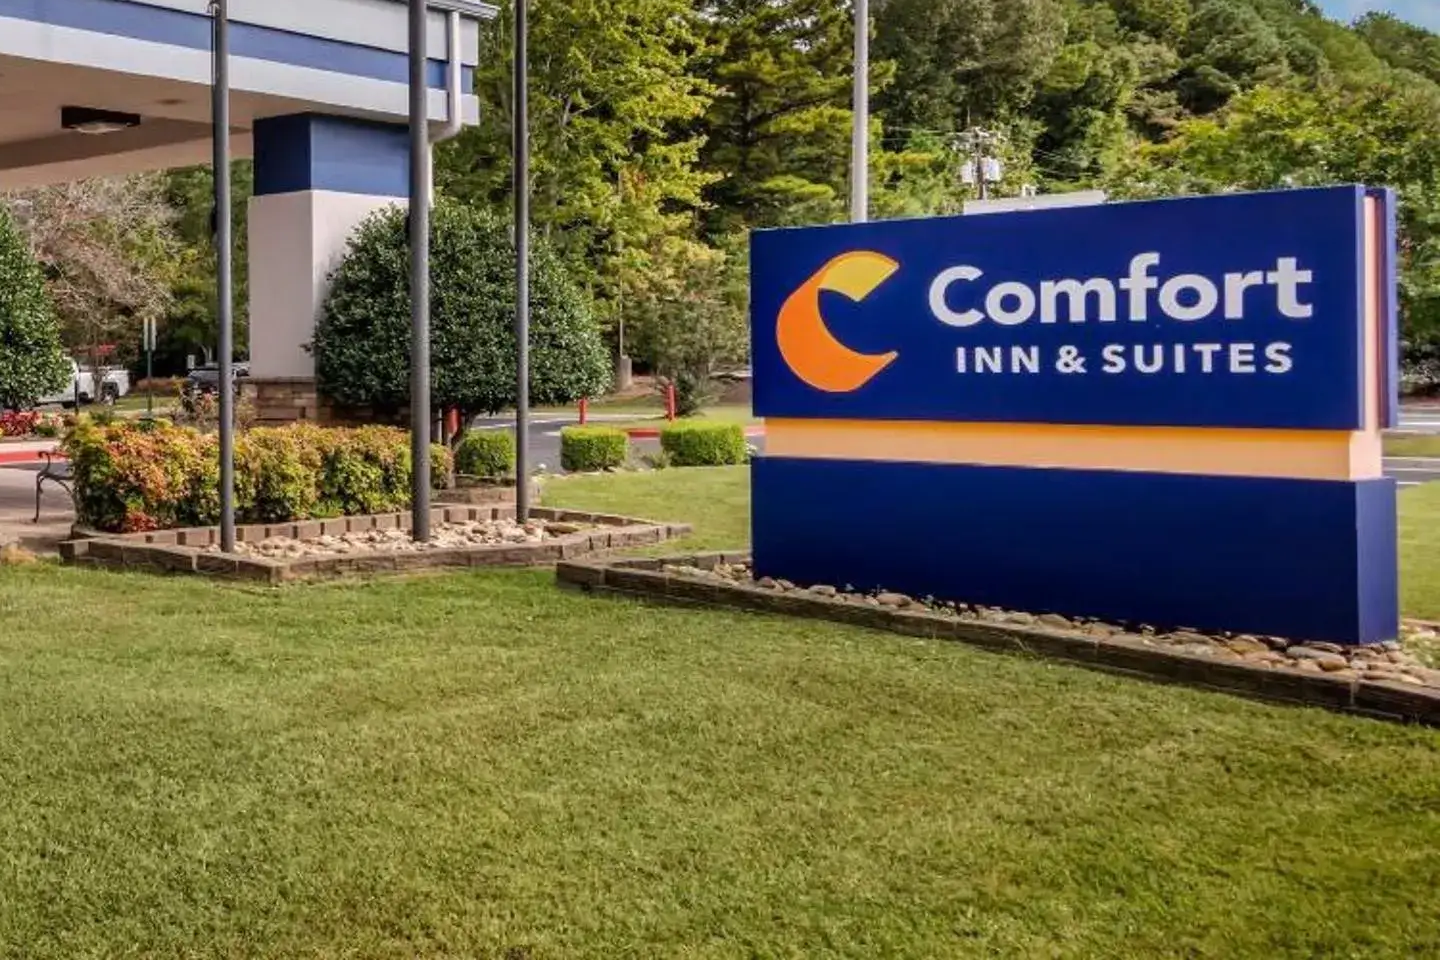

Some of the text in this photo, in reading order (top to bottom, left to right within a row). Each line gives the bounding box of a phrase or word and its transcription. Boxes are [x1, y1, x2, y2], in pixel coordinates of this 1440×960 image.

[928, 251, 1314, 327] Comfort
[955, 342, 1294, 374] INN & SUITES
